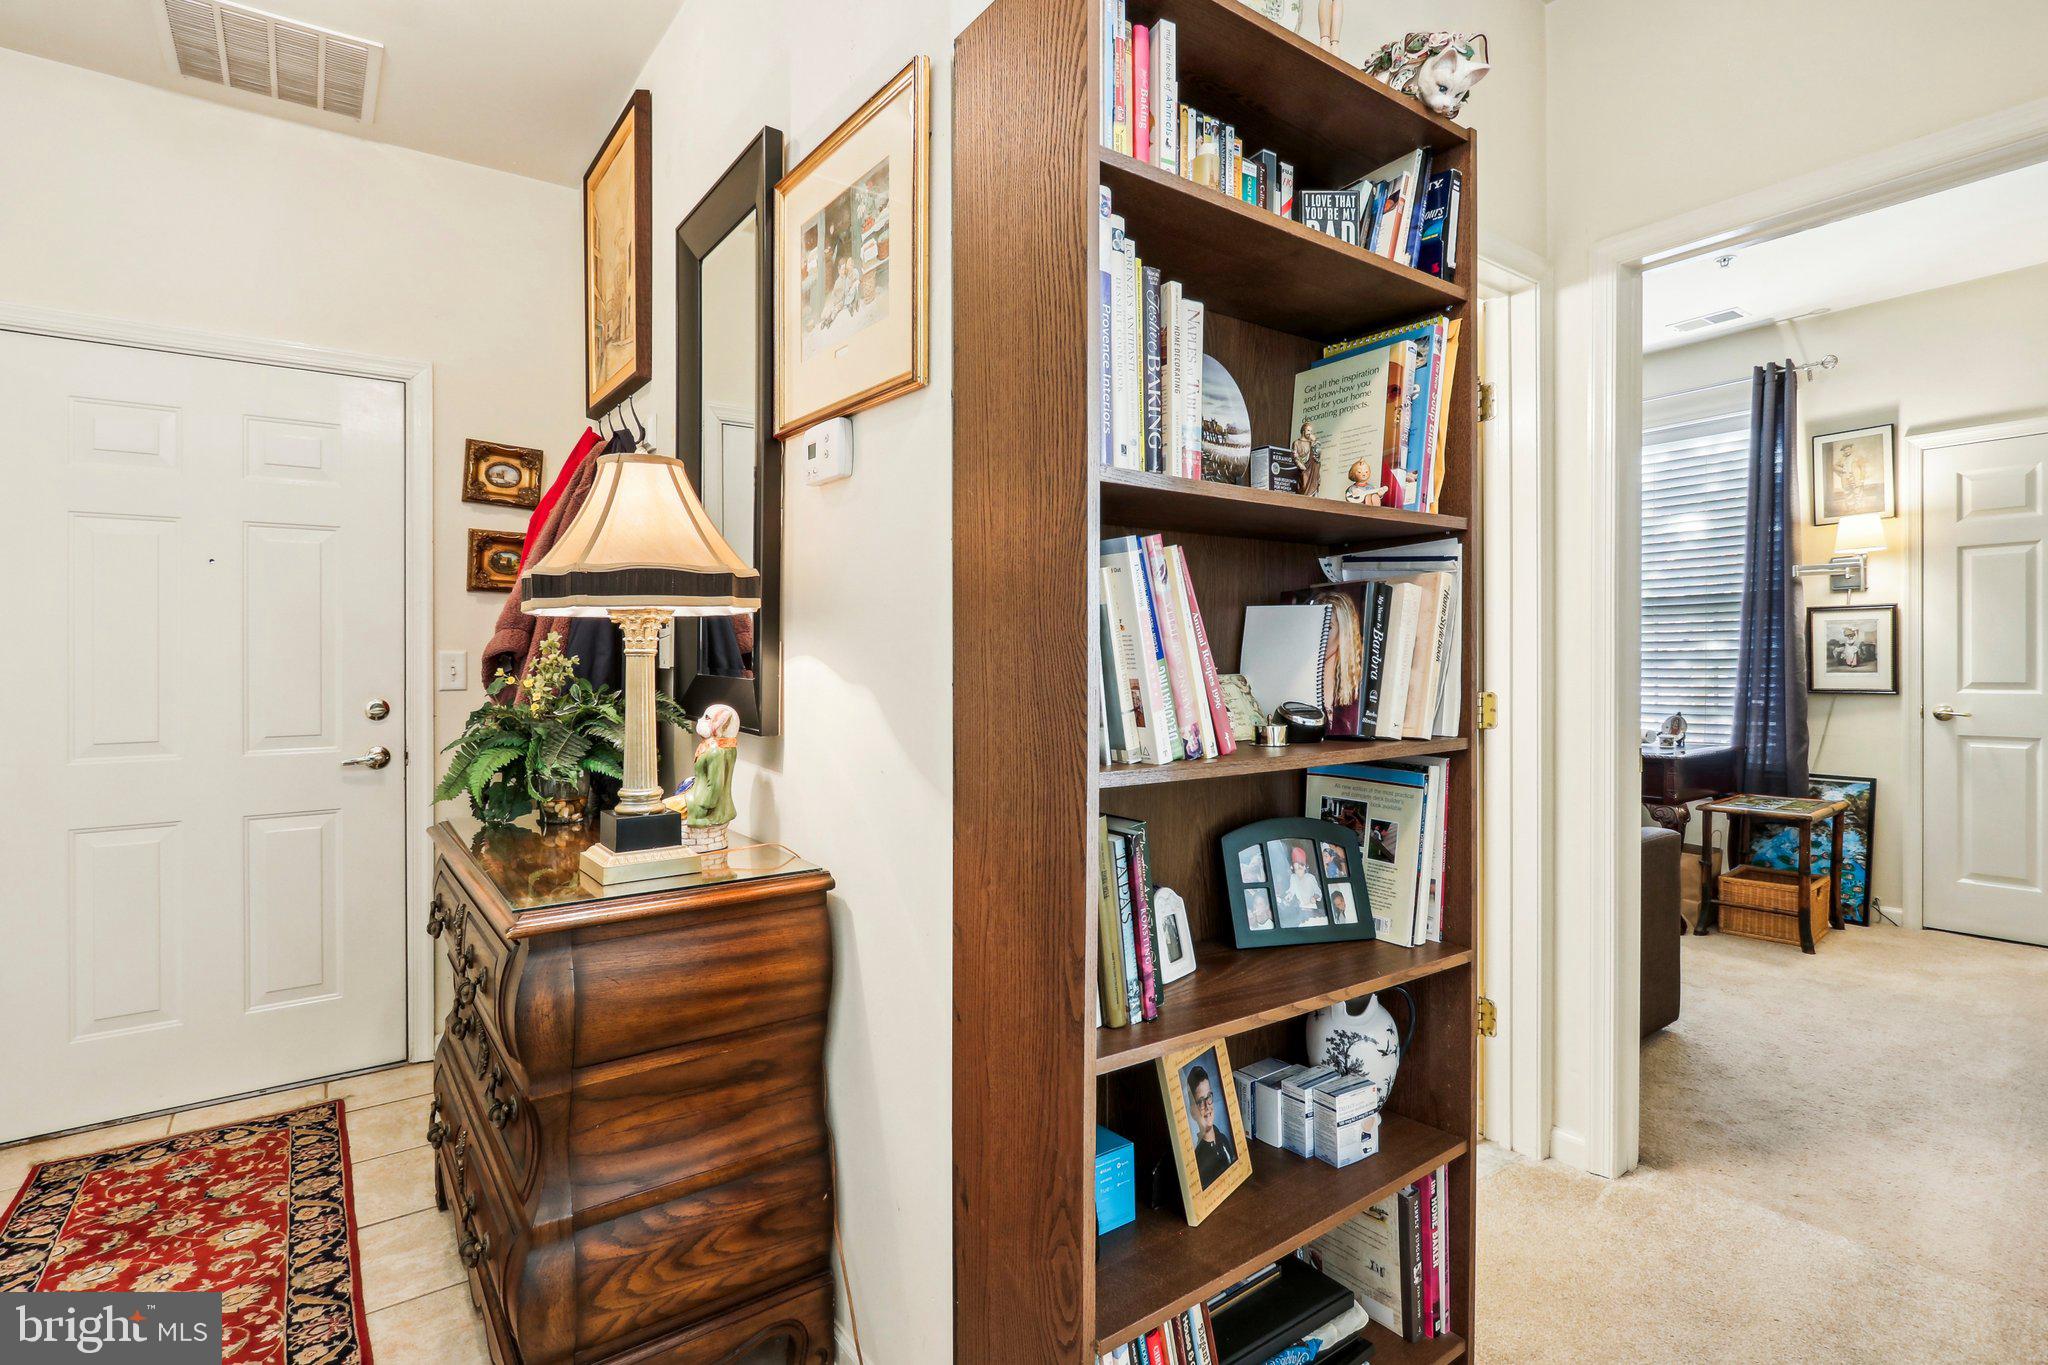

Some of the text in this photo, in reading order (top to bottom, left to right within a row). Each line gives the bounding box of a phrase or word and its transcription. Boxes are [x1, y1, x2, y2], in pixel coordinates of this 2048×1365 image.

[1164, 29, 1174, 137] my little book of Animals
[1139, 88, 1149, 130] Baking
[1304, 194, 1355, 208] I LOVE THAT
[1305, 206, 1356, 221] YOU'RE MY
[1186, 309, 1200, 364] NAPLES
[1102, 303, 1112, 435] Provence Interiors
[1304, 366, 1380, 394] Get all the inspiration
[1147, 353, 1162, 450] BAKING
[1186, 379, 1200, 424] TABLE
[1302, 390, 1371, 414] need for your home
[1303, 380, 1371, 404] and know-how you
[1429, 391, 1438, 421] Soup
[1301, 401, 1368, 424] decorating projects.
[1426, 423, 1437, 455] Bible
[1378, 595, 1384, 604] My
[1441, 590, 1451, 616] Home
[1437, 617, 1448, 639] Style
[1192, 611, 1221, 709] Annual Recipes 1996
[1370, 628, 1384, 680] Barbra
[1116, 853, 1132, 925] TAPAS
[1140, 907, 1152, 965] ROASTING
[1430, 1195, 1439, 1230] HOME
[1431, 1230, 1439, 1268] BAKER
[1182, 1314, 1195, 1361] House &
[1197, 1323, 1210, 1362] Elegant
